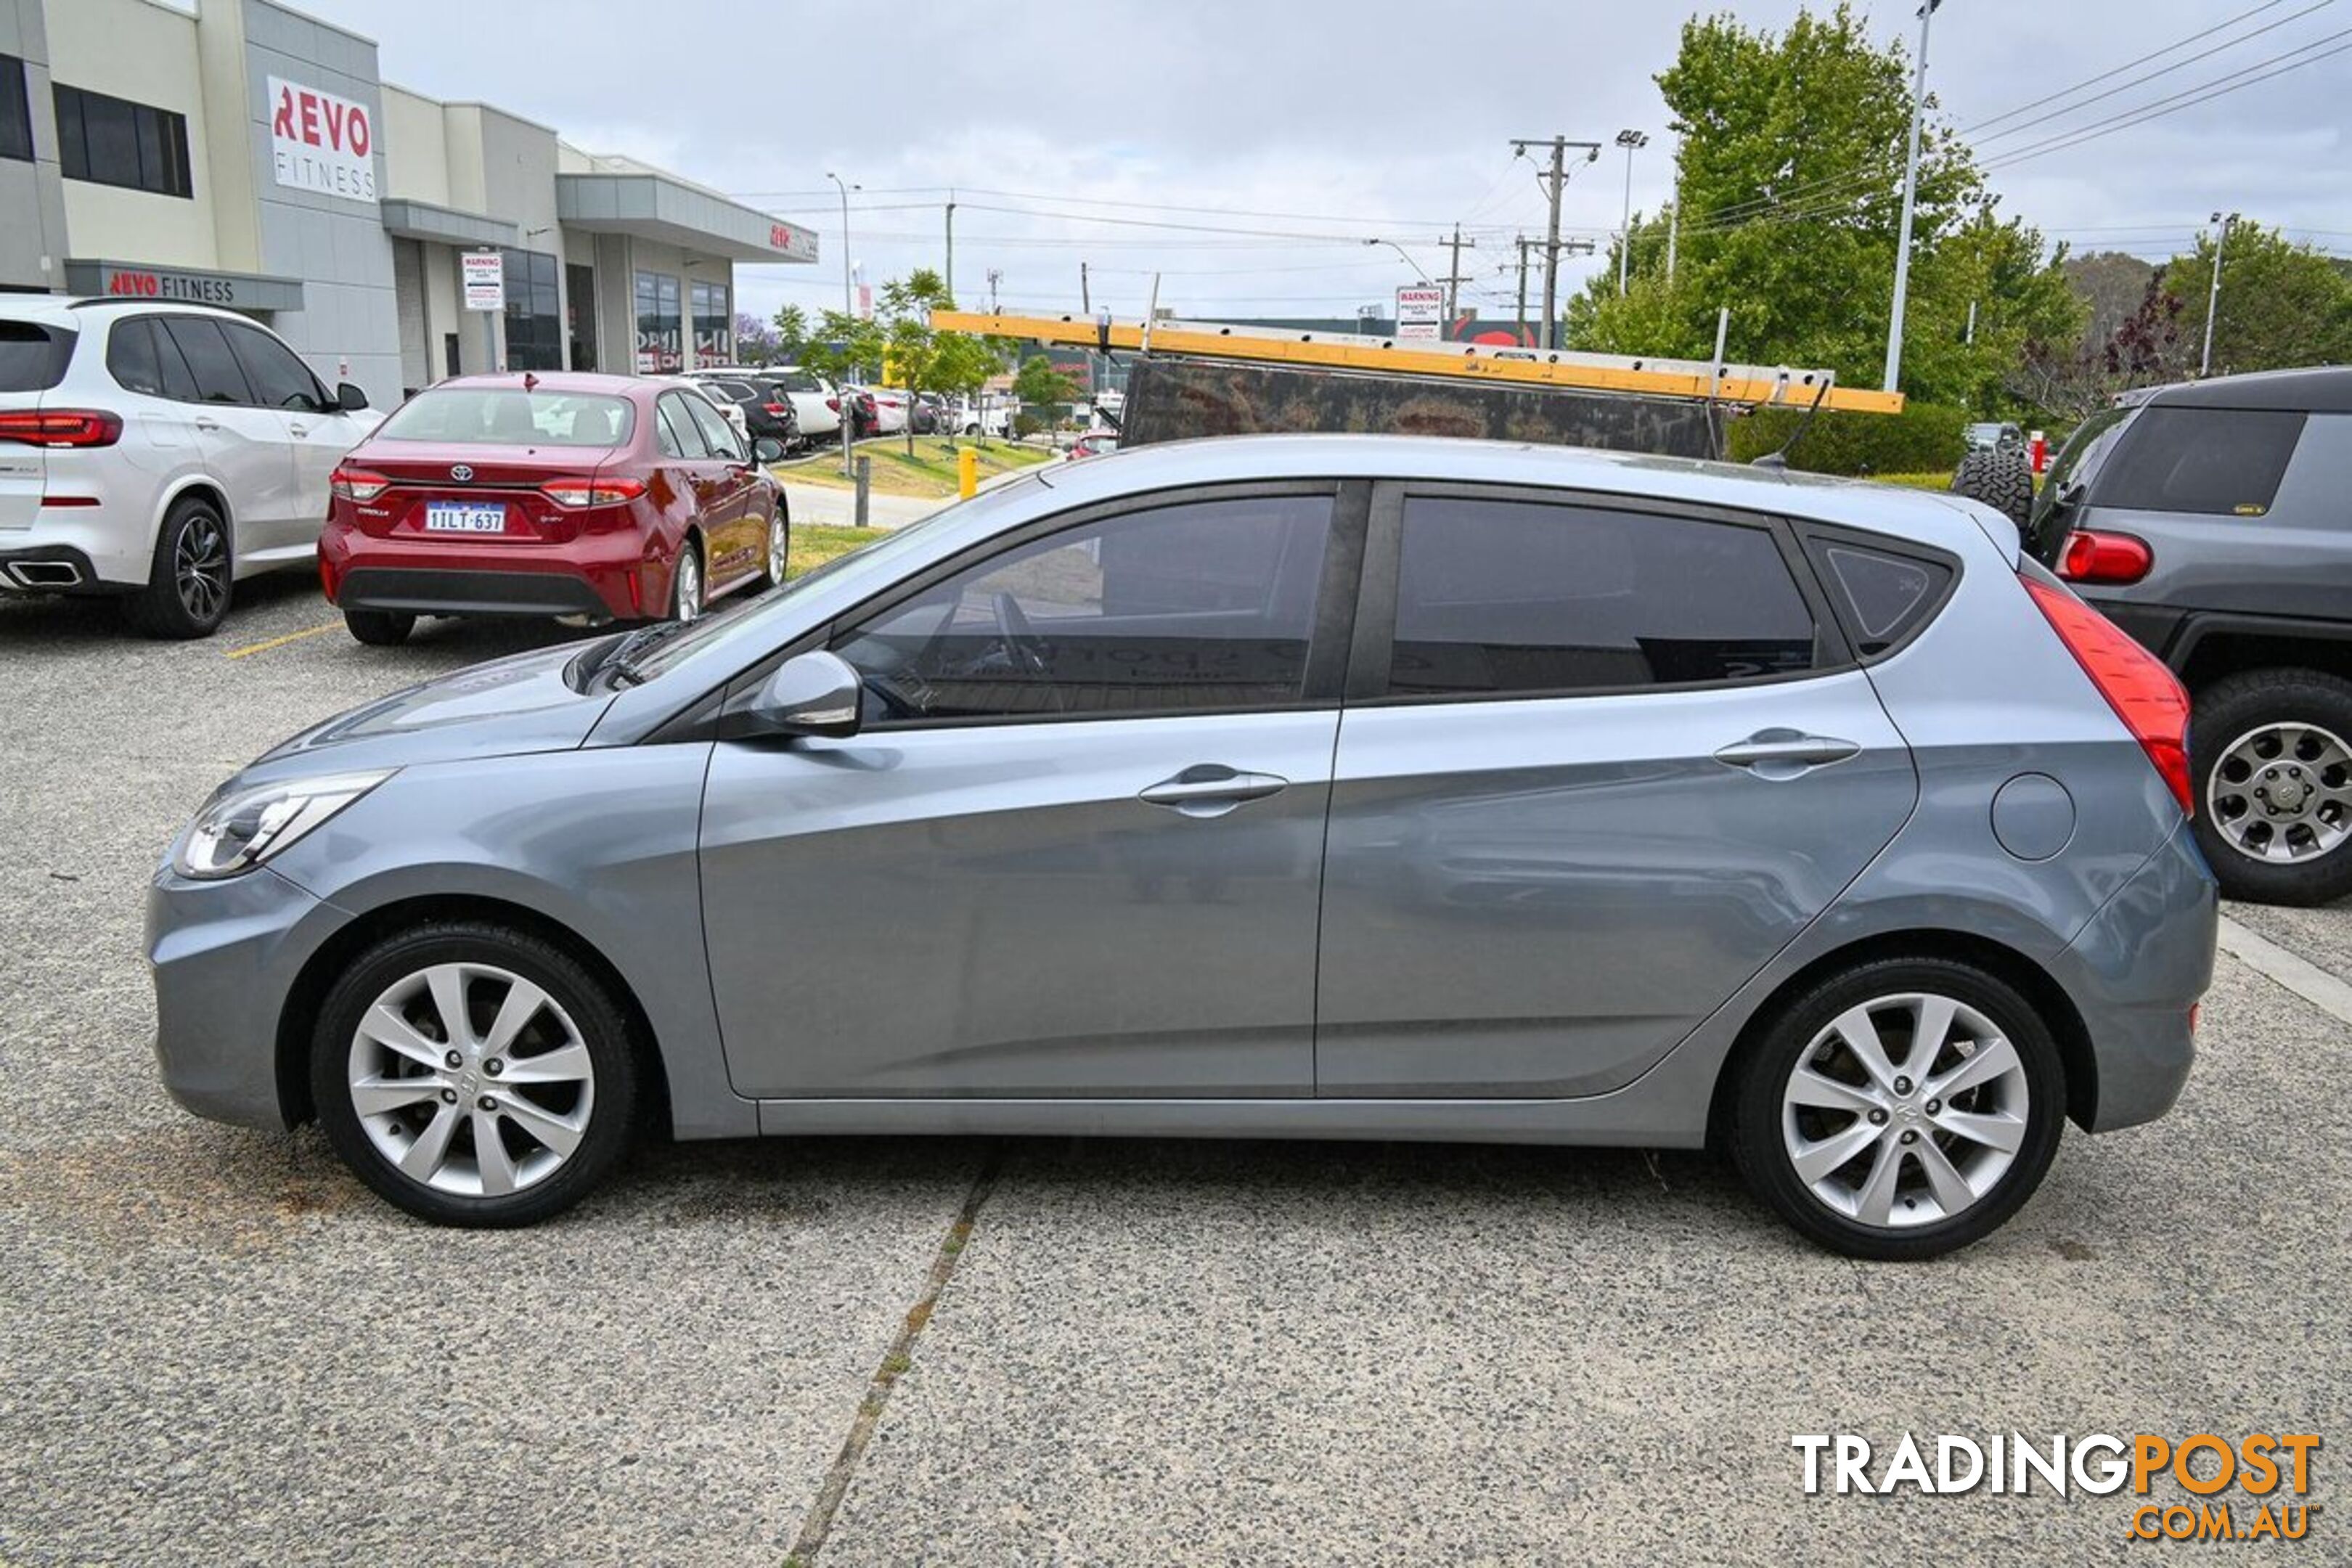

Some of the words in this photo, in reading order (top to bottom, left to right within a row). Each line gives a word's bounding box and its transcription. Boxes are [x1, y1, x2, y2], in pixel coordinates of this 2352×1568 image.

[274, 85, 369, 158] REVO
[276, 151, 374, 197] FITNESS
[110, 271, 158, 296] REVO
[161, 277, 234, 302] FITNESS
[1401, 292, 1439, 301] WARNING
